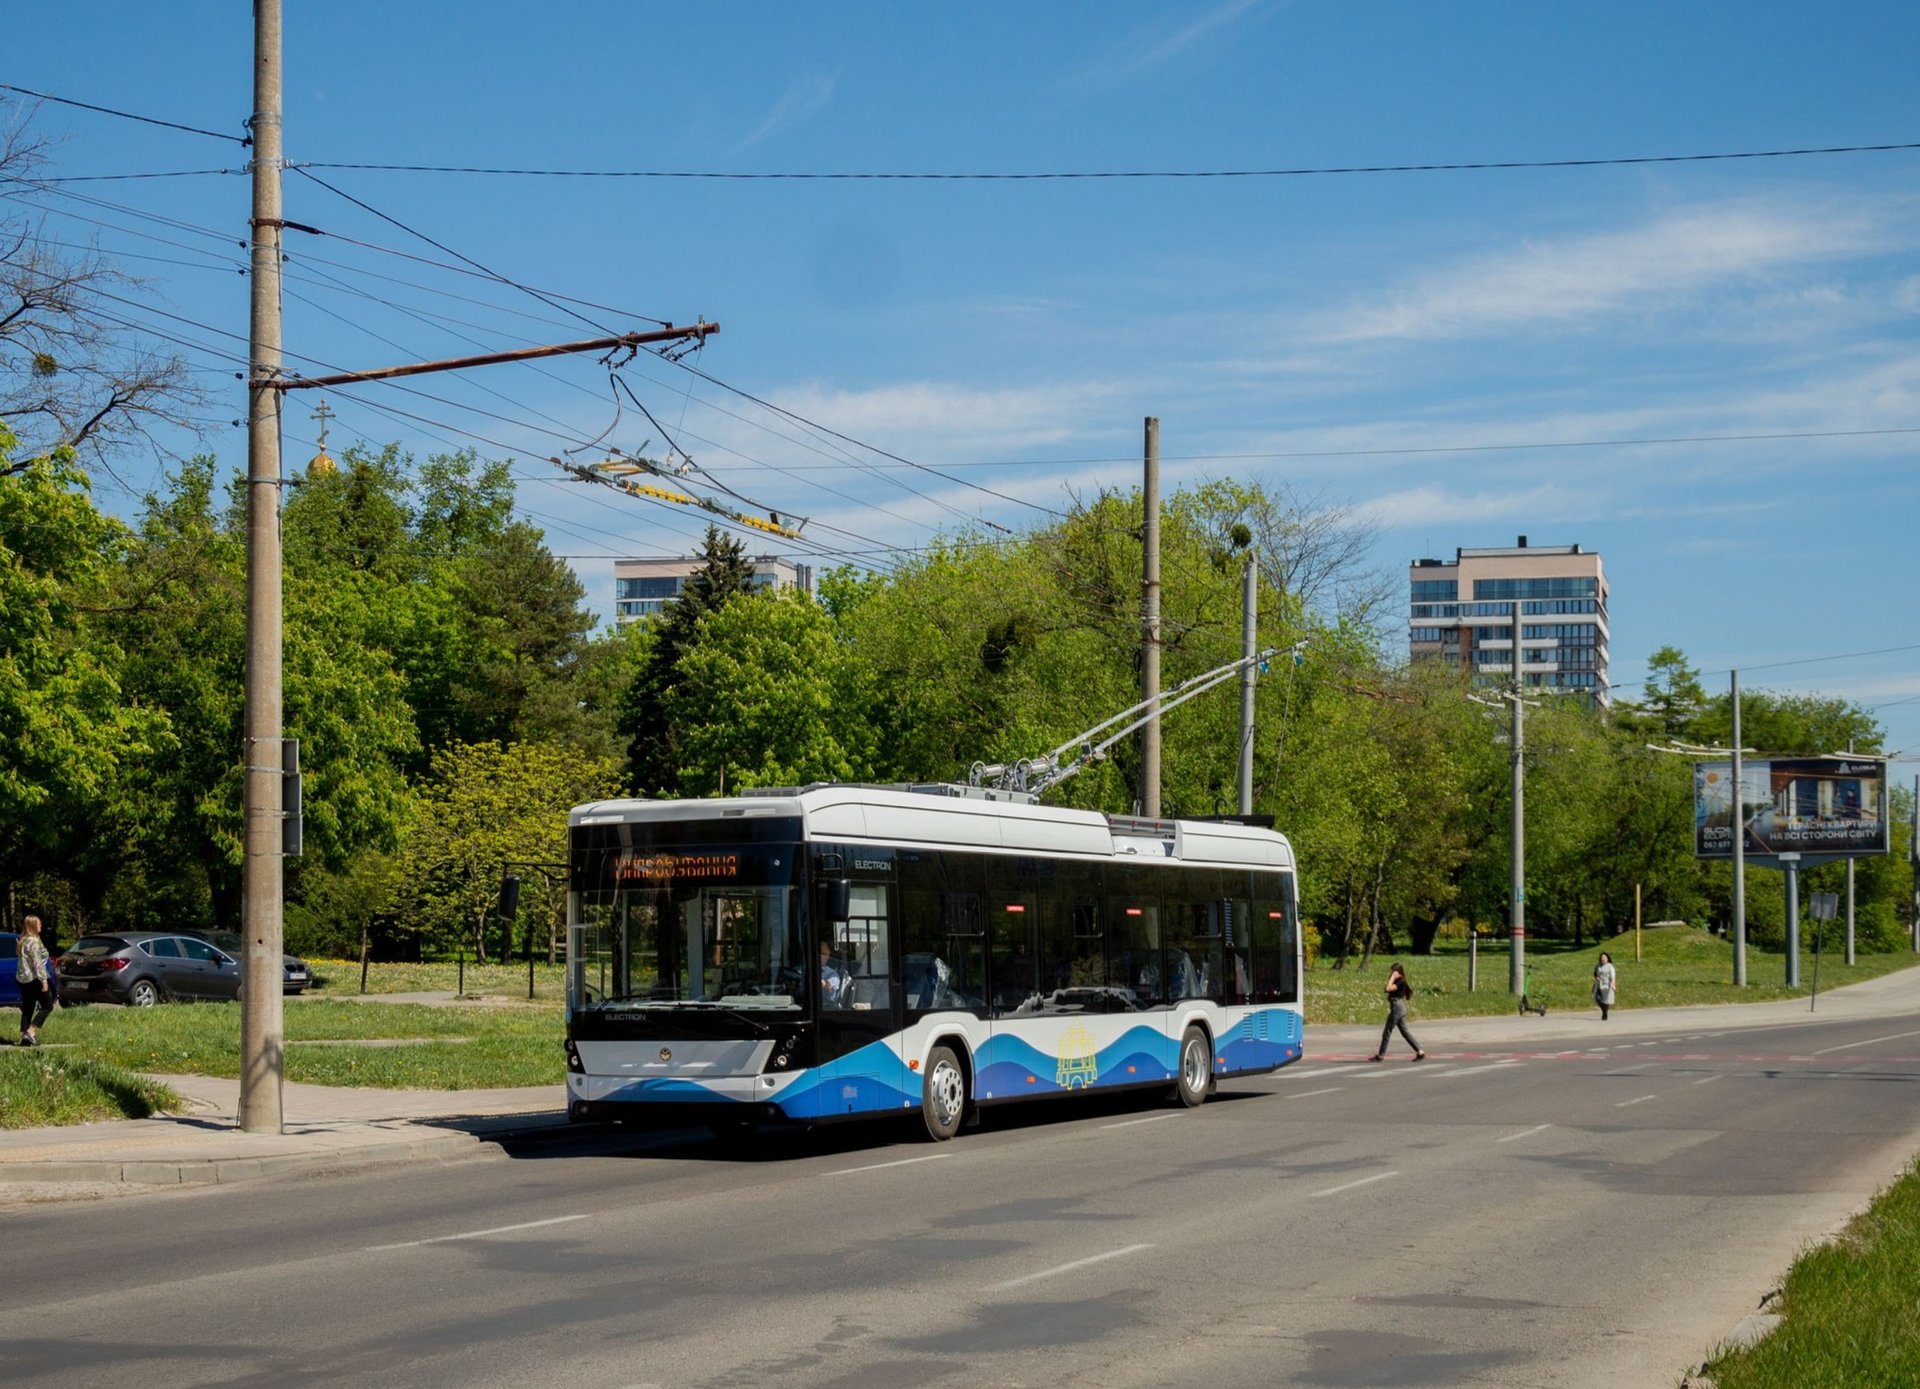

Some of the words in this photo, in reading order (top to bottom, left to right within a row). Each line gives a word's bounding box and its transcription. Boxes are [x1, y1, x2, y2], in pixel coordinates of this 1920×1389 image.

[1827, 819, 1877, 829] КВАРТИРИ
[1769, 832, 1783, 840] НА
[1801, 830, 1848, 839] СТОРОНИ
[1849, 829, 1877, 838] СВІТУ
[855, 860, 891, 870] ELECTRON
[605, 1013, 647, 1021] ELECTRON
